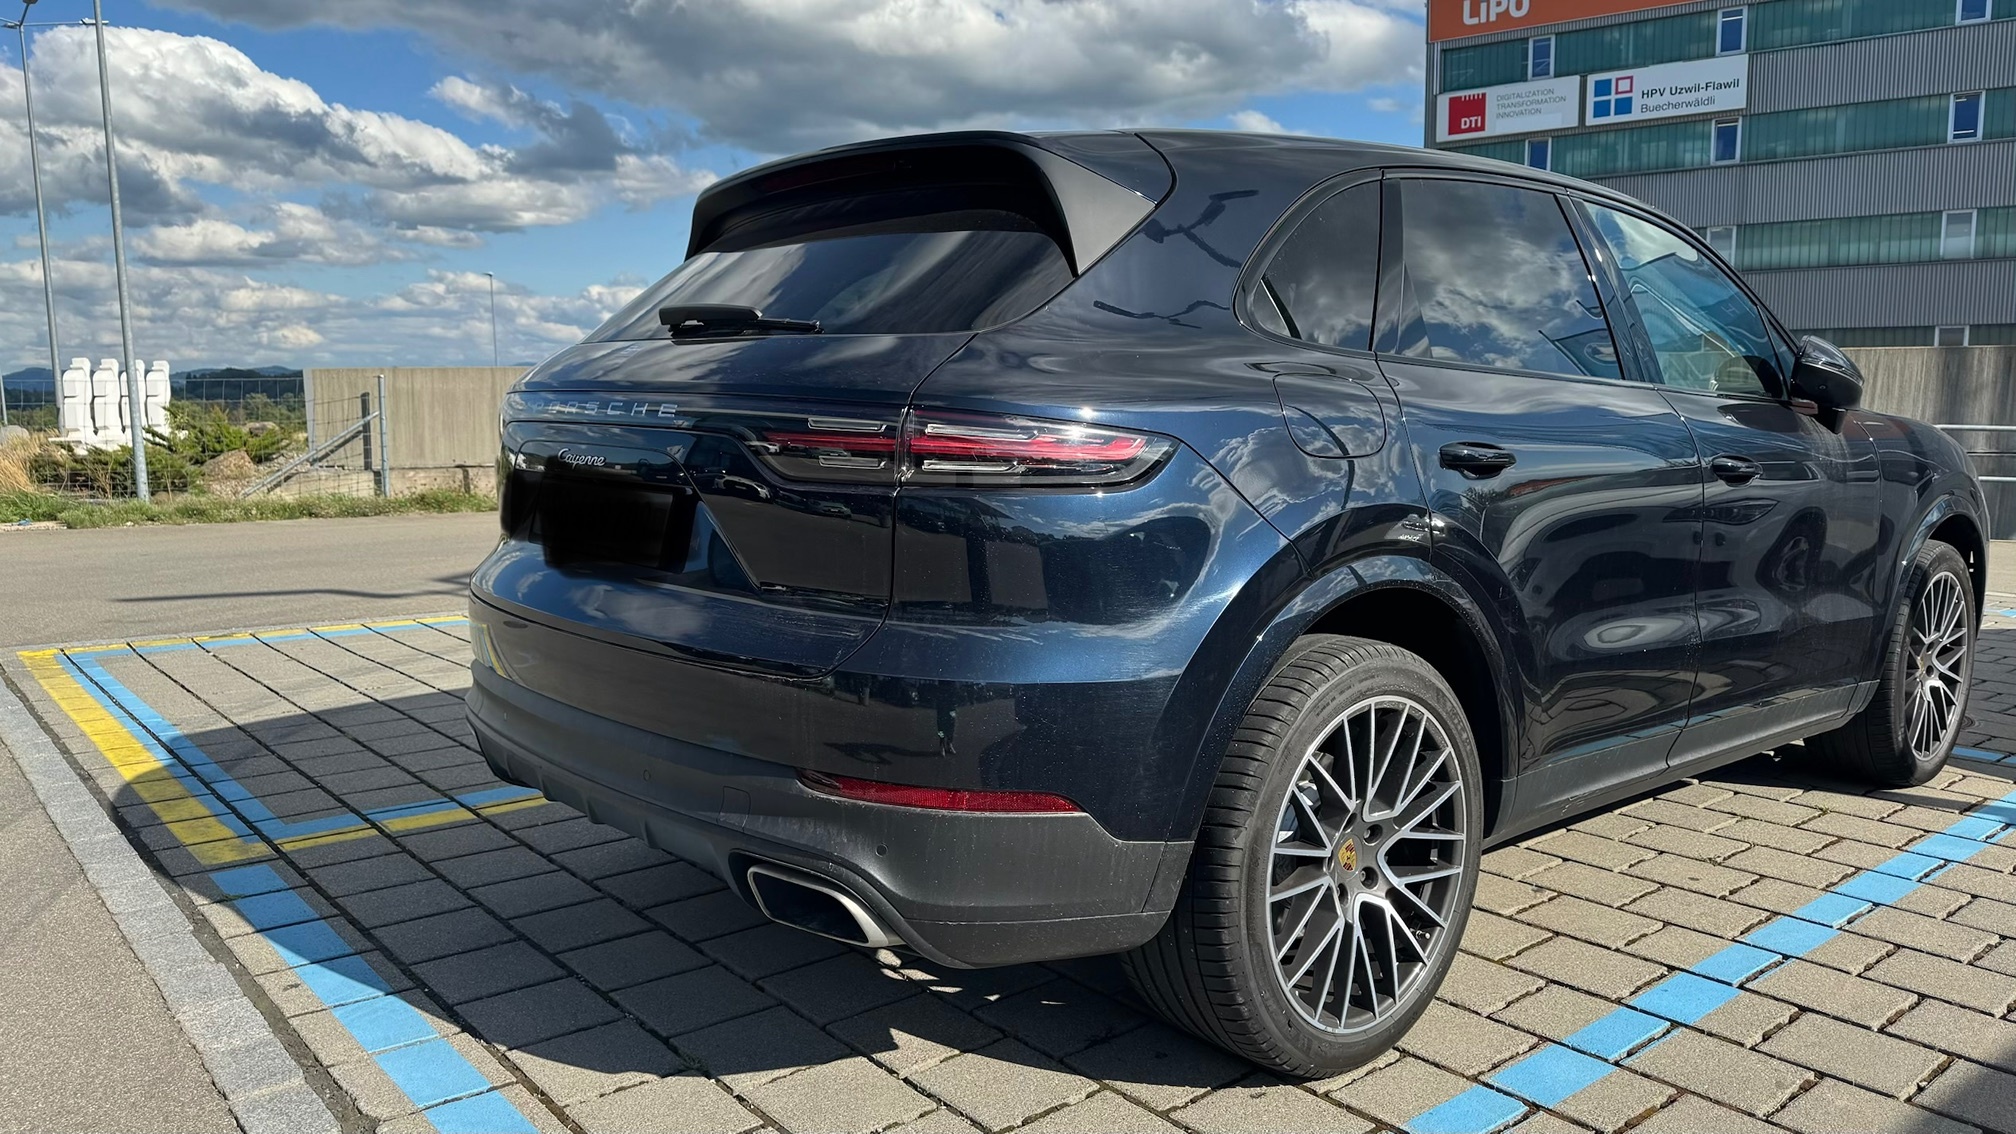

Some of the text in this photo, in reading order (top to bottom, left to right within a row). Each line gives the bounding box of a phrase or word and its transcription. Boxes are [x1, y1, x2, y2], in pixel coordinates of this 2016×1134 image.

[1496, 88, 1554, 102] DIGITALIZATION
[1641, 78, 1740, 99] HPV Uzwil-Flawil
[1496, 95, 1566, 111] TRANSFORMATION
[1640, 95, 1716, 113] Buecherwäldli
[1496, 107, 1542, 119] INNOVATION
[1460, 115, 1482, 129] DTI
[557, 448, 606, 469] Cayenne
